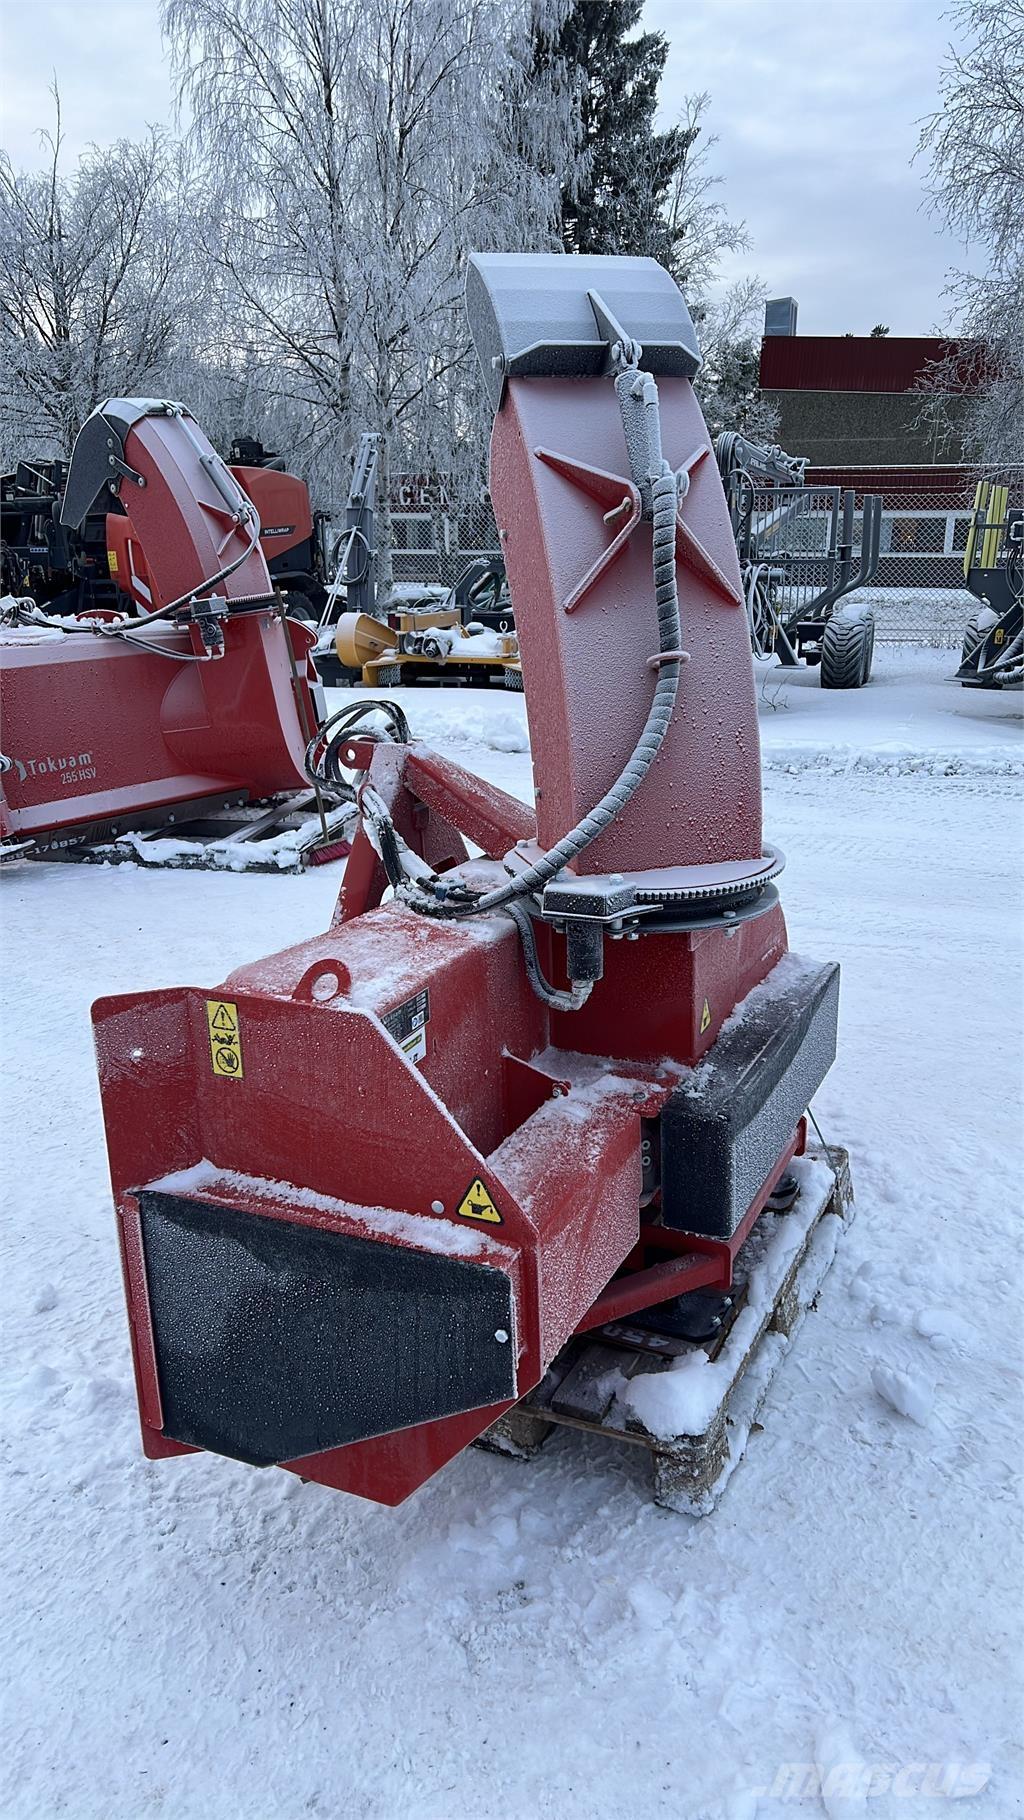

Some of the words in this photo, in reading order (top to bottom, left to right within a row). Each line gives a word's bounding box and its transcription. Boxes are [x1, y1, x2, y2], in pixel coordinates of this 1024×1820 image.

[27, 753, 92, 776] Tokvam
[61, 771, 78, 785] 255
[79, 767, 97, 781] HSV
